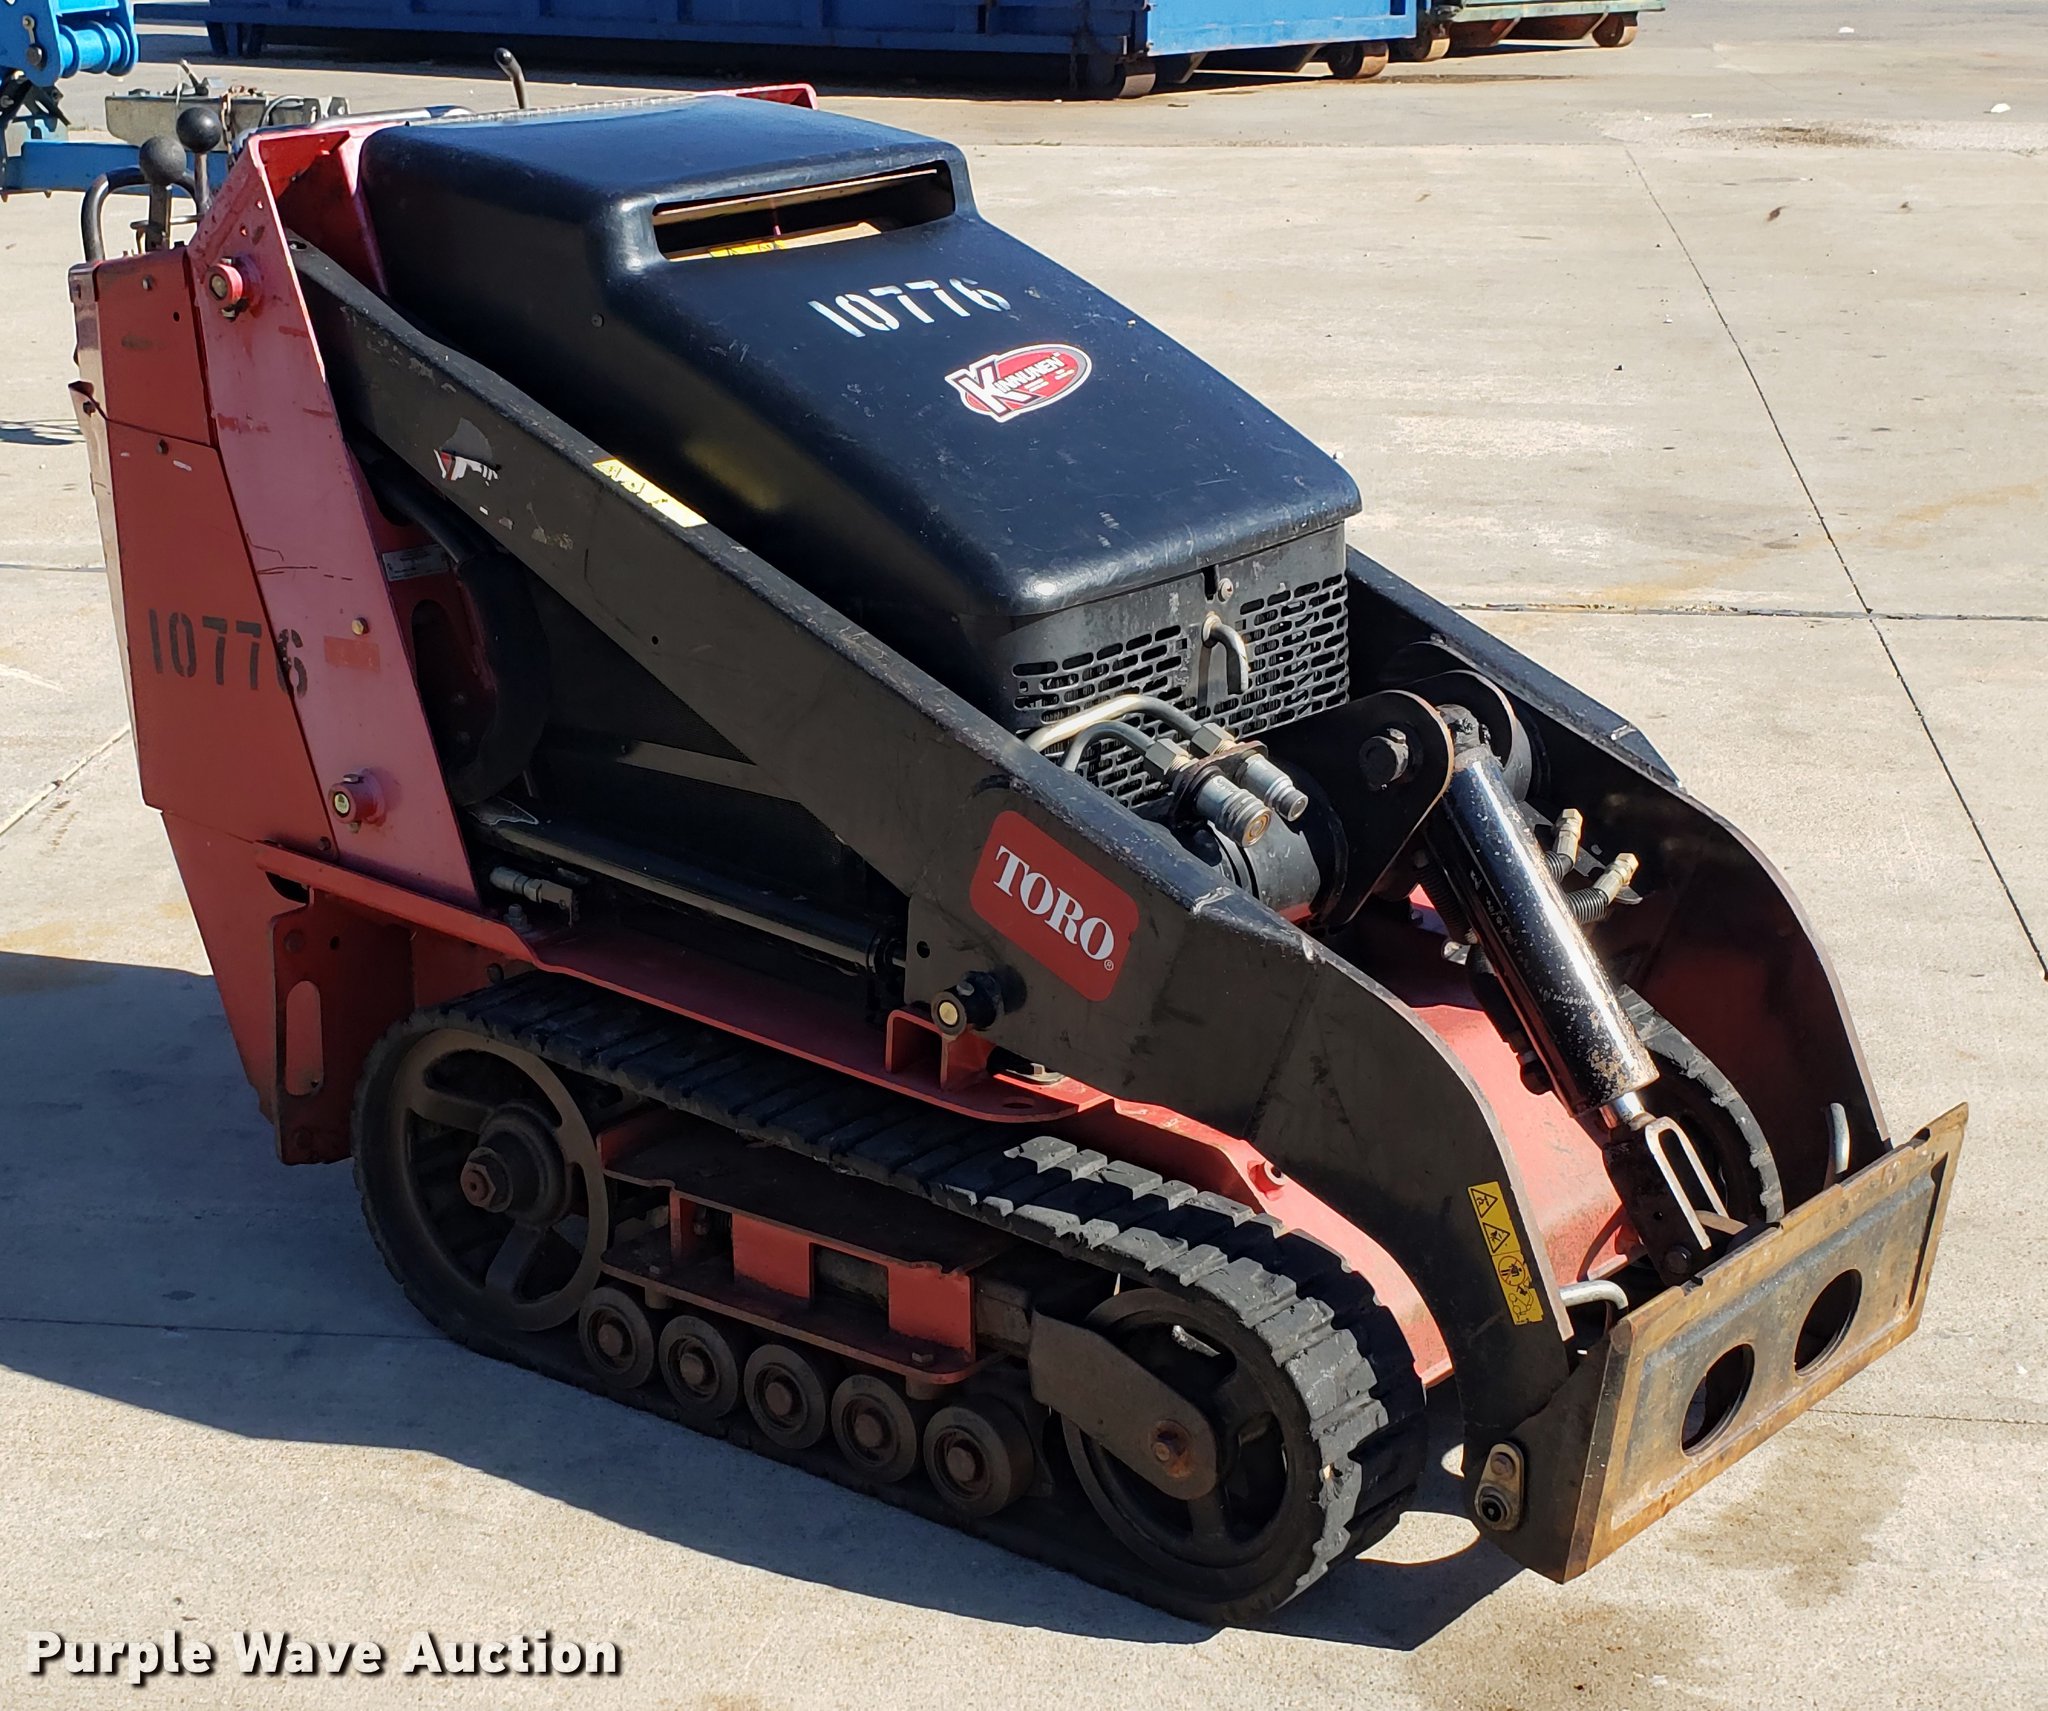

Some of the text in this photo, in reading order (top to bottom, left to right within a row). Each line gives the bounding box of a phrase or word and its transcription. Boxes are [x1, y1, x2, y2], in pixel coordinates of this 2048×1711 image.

[807, 278, 1012, 338] 10776
[955, 355, 1066, 416] KINNUNEN
[148, 608, 309, 700] 10776
[993, 845, 1115, 961] TORO
